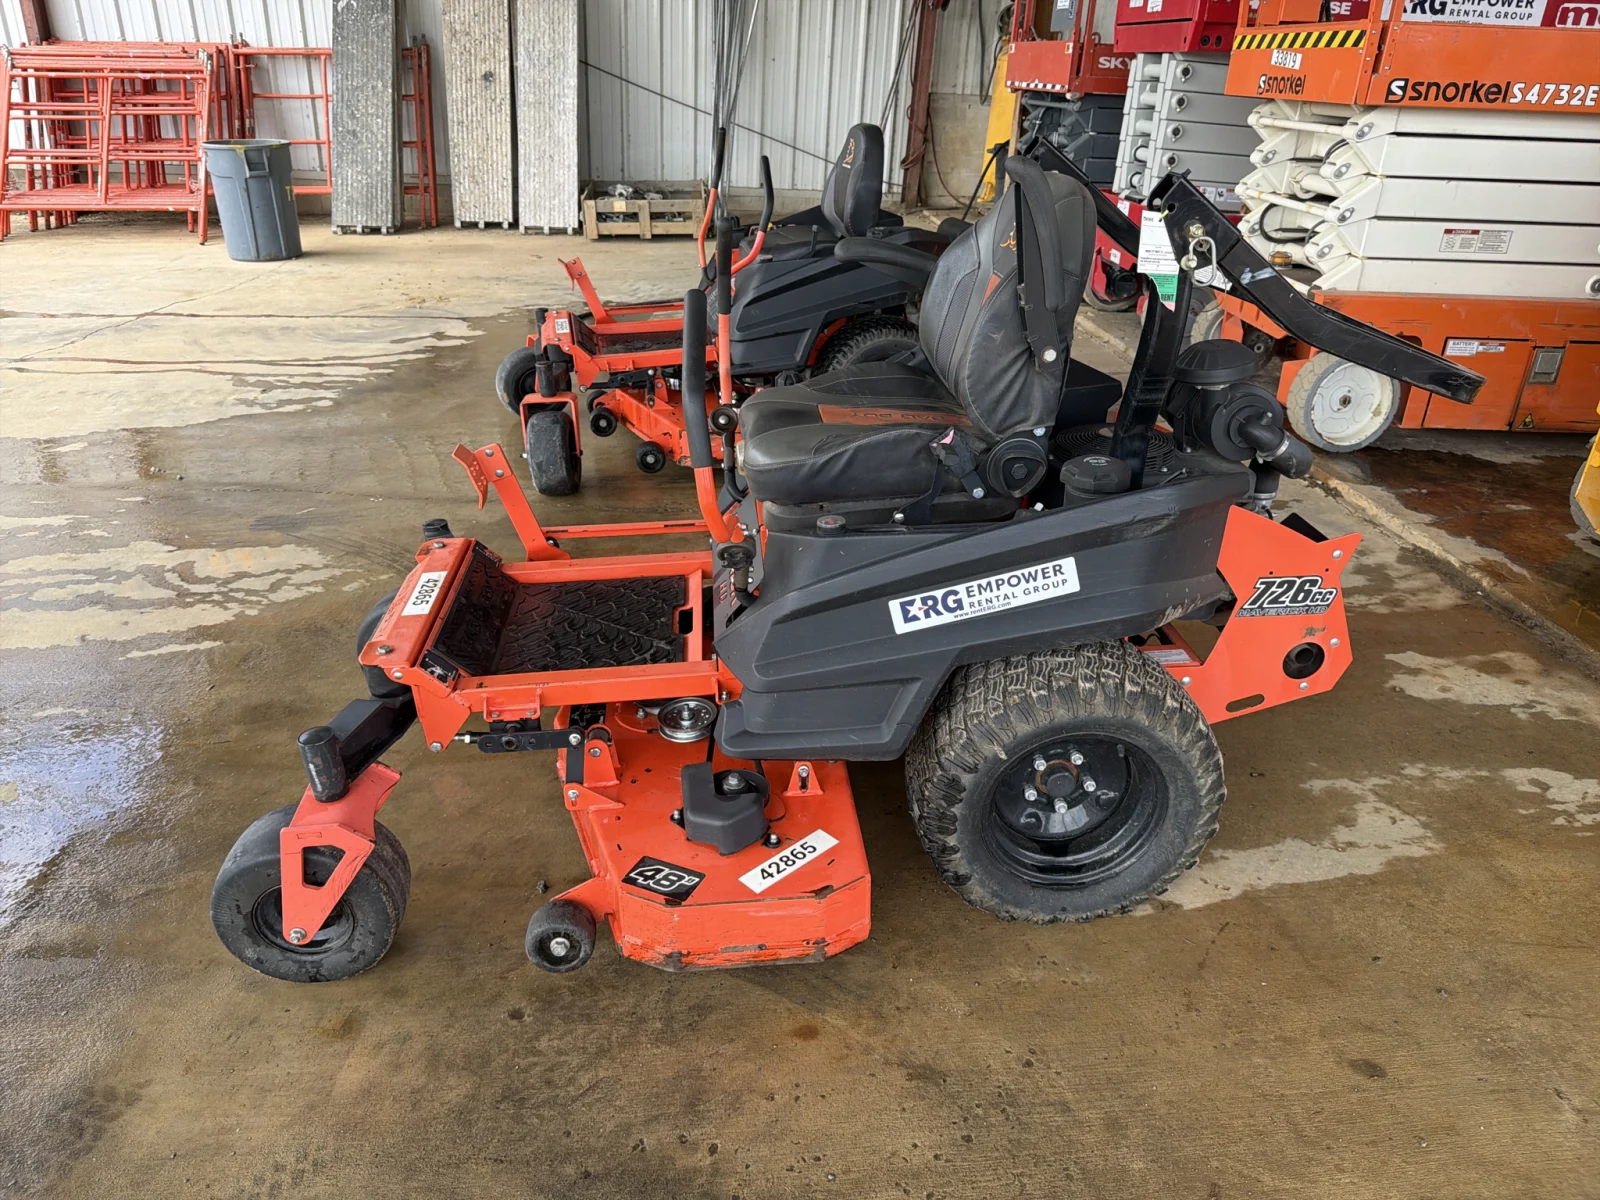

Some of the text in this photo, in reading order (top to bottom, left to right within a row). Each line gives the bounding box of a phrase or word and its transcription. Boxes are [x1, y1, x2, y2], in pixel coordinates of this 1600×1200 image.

[1403, 0, 1447, 15] RG
[1449, 9, 1533, 21] RENTAL GROUP
[1557, 6, 1600, 26] m
[1274, 50, 1297, 68] 33819
[1266, 74, 1306, 95] snorkel
[1409, 80, 1600, 107] snorkel S4732E
[965, 564, 1065, 598] EMPOWER
[412, 578, 440, 606] 42865
[969, 578, 1068, 609] RENTAL GROUP
[900, 589, 965, 624] ERG
[953, 601, 1012, 620] www.rentERG.com
[1237, 605, 1328, 617] MAVERICK HD
[759, 840, 818, 882] 42865
